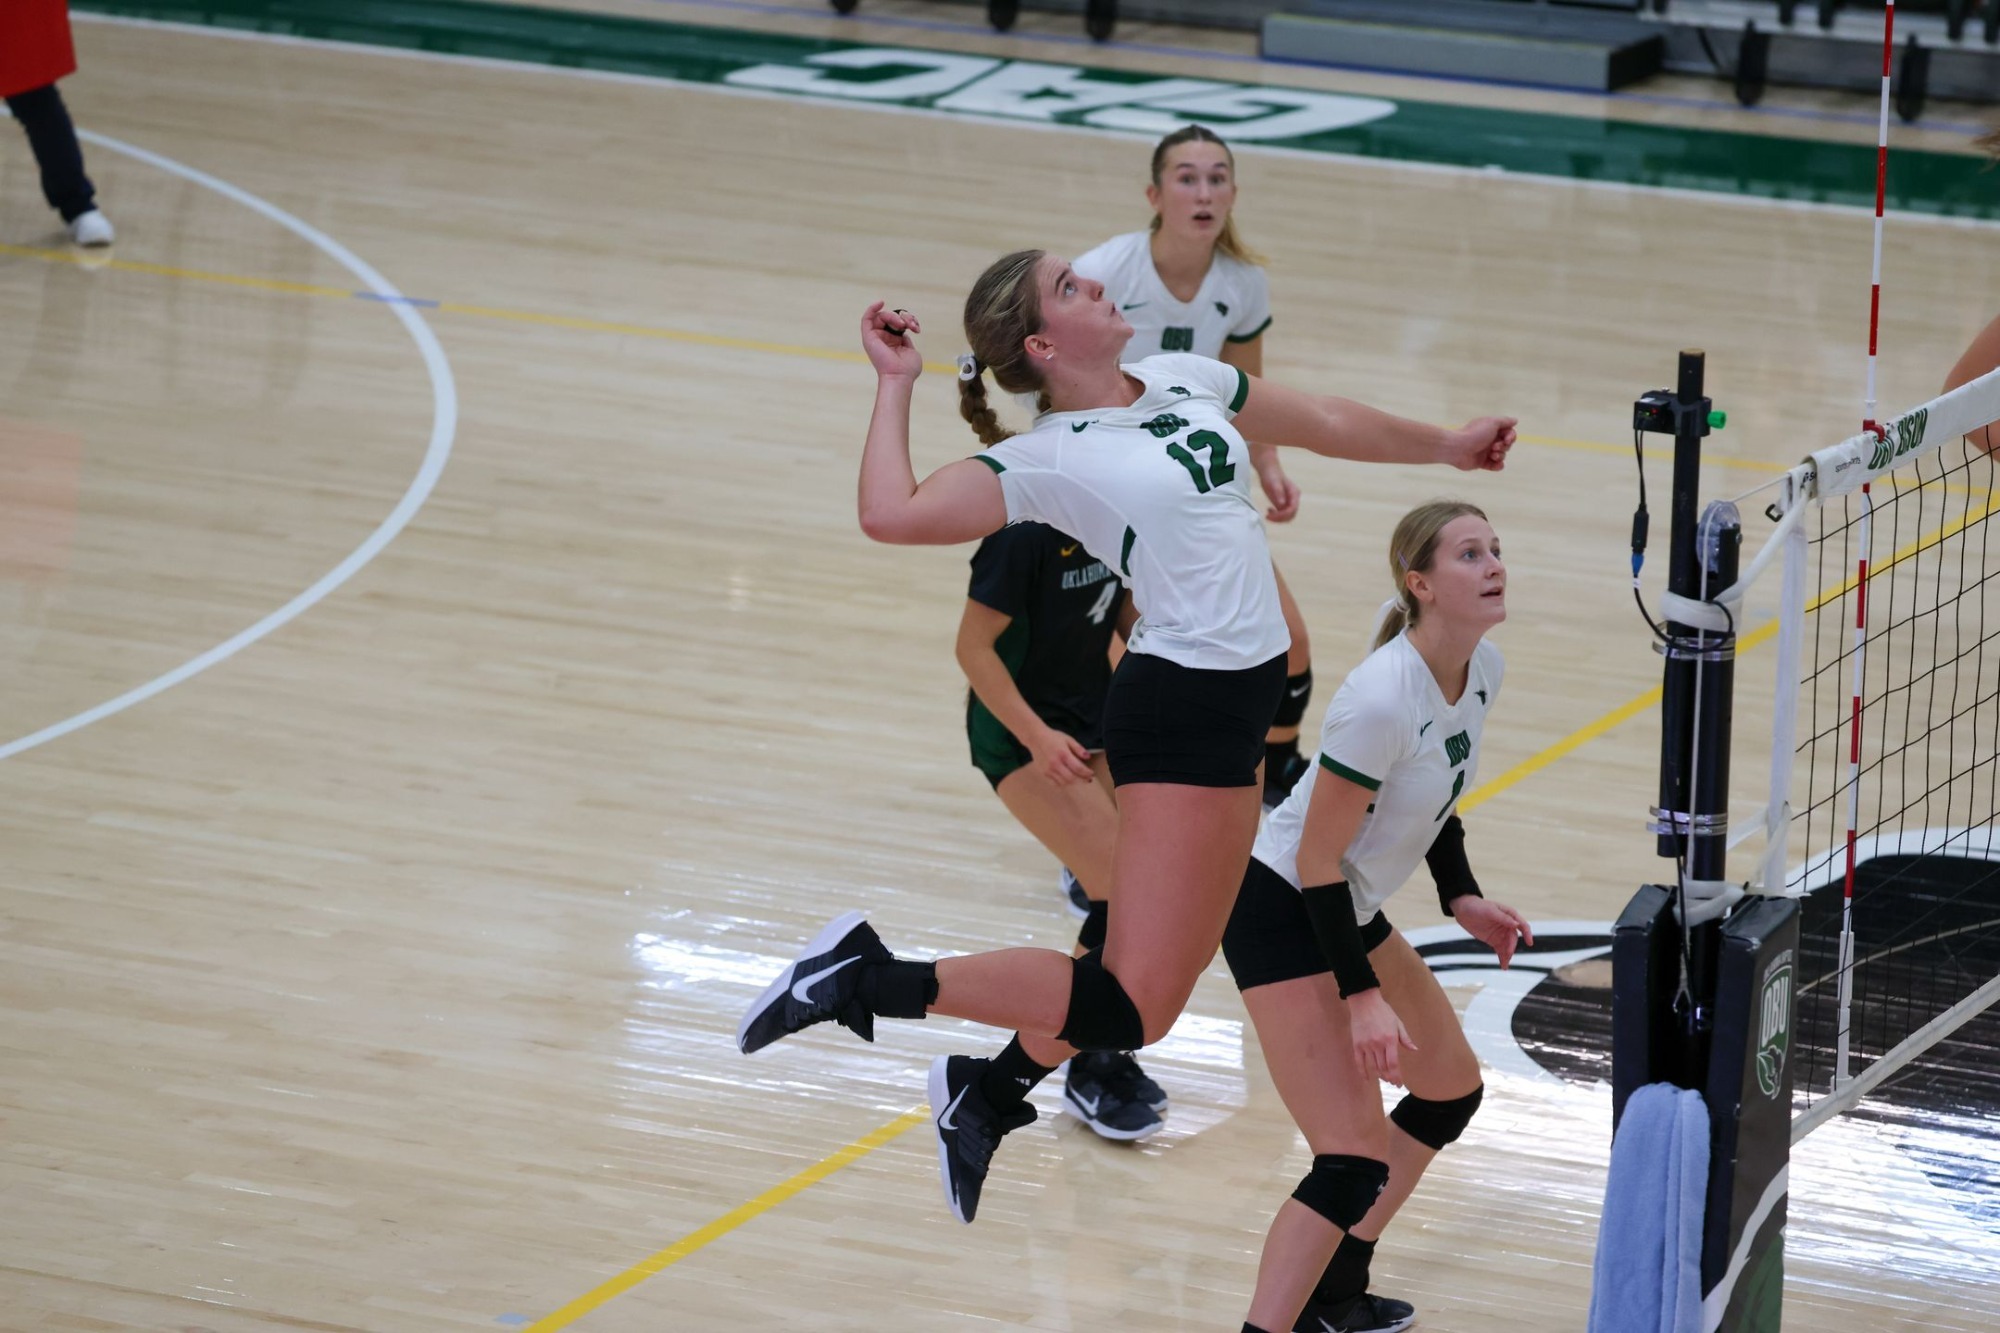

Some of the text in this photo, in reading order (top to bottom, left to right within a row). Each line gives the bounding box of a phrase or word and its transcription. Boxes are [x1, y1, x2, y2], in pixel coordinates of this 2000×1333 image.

[1897, 408, 1928, 456] BISON
[1166, 429, 1236, 494] 12
[1086, 581, 1117, 625] 4
[1761, 976, 1788, 1047] OBU
